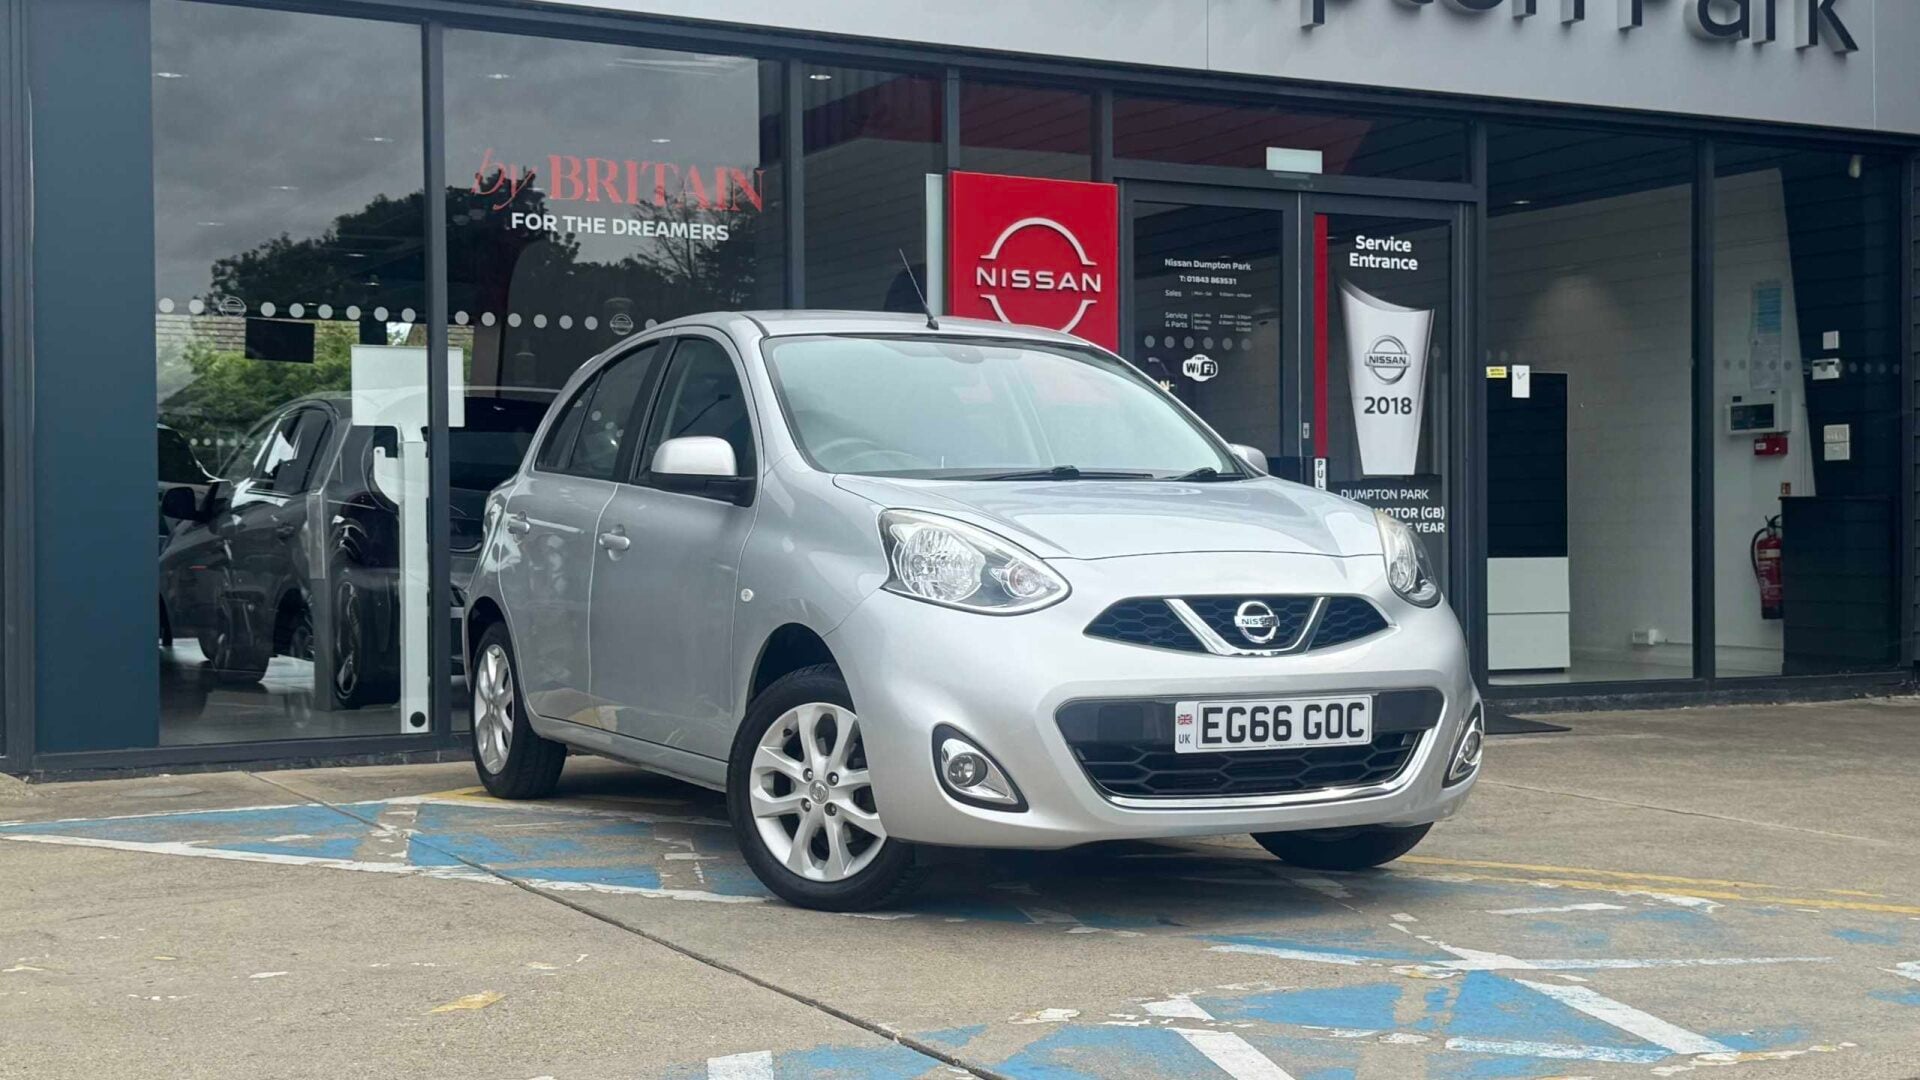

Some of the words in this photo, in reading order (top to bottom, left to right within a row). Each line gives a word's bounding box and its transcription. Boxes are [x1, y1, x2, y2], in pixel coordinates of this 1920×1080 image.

[471, 148, 538, 210] by
[547, 154, 765, 213] BRITAIN
[511, 212, 557, 231] FOR
[562, 215, 606, 234] THE
[612, 218, 729, 241] DREAMERS
[1355, 235, 1412, 252] Service
[1164, 259, 1192, 268] Nissan
[1193, 261, 1231, 271] Dumpton
[1232, 263, 1252, 271] Park
[1349, 253, 1418, 270] Entrance
[976, 266, 1101, 293] NISSAN
[1165, 290, 1182, 298] Sales
[1165, 312, 1188, 320] Service
[1368, 355, 1407, 366] NISSAN
[1364, 396, 1412, 415] 2018
[1340, 489, 1398, 500] DUMPTON
[1400, 489, 1429, 500] PARK
[1375, 507, 1418, 519] OTOR
[1421, 506, 1445, 520] (GB)
[1415, 522, 1445, 533] YEAR
[1202, 705, 1292, 744] EG66
[1303, 702, 1365, 740] GOC
[1178, 734, 1191, 744] UK
